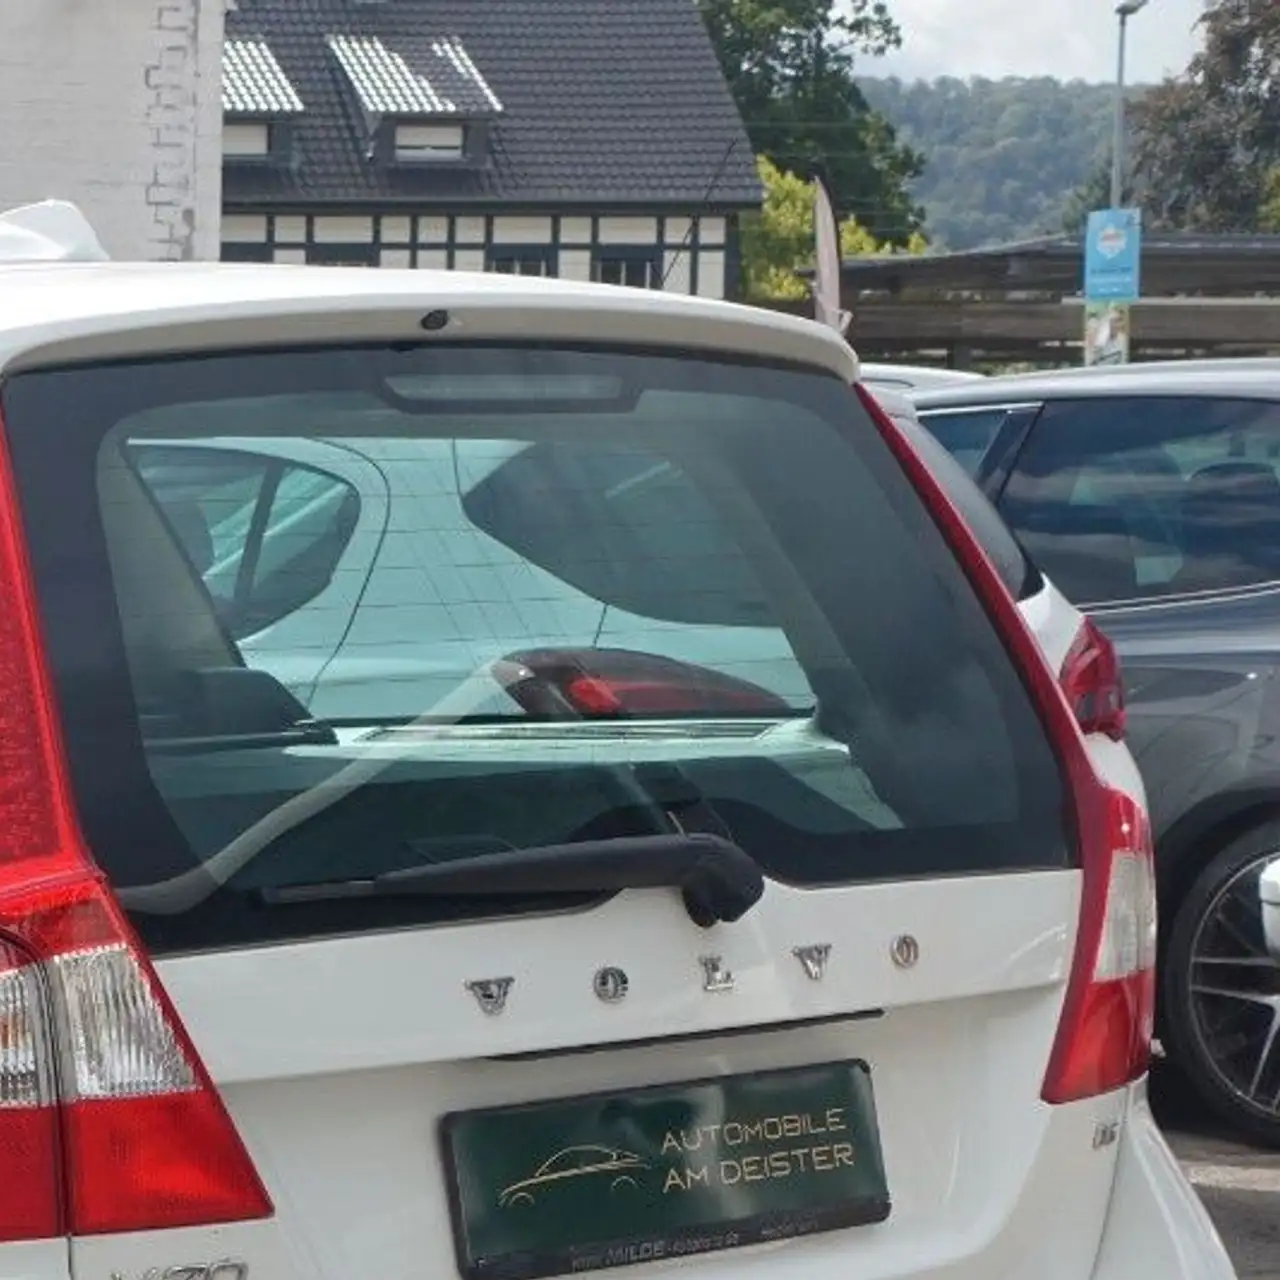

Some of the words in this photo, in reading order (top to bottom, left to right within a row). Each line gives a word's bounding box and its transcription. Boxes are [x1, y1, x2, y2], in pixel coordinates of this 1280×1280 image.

[463, 933, 920, 1016] VOLVO
[660, 1107, 847, 1156] AUTOMOBILE
[662, 1164, 709, 1194] AM
[719, 1142, 855, 1185] DEISTER
